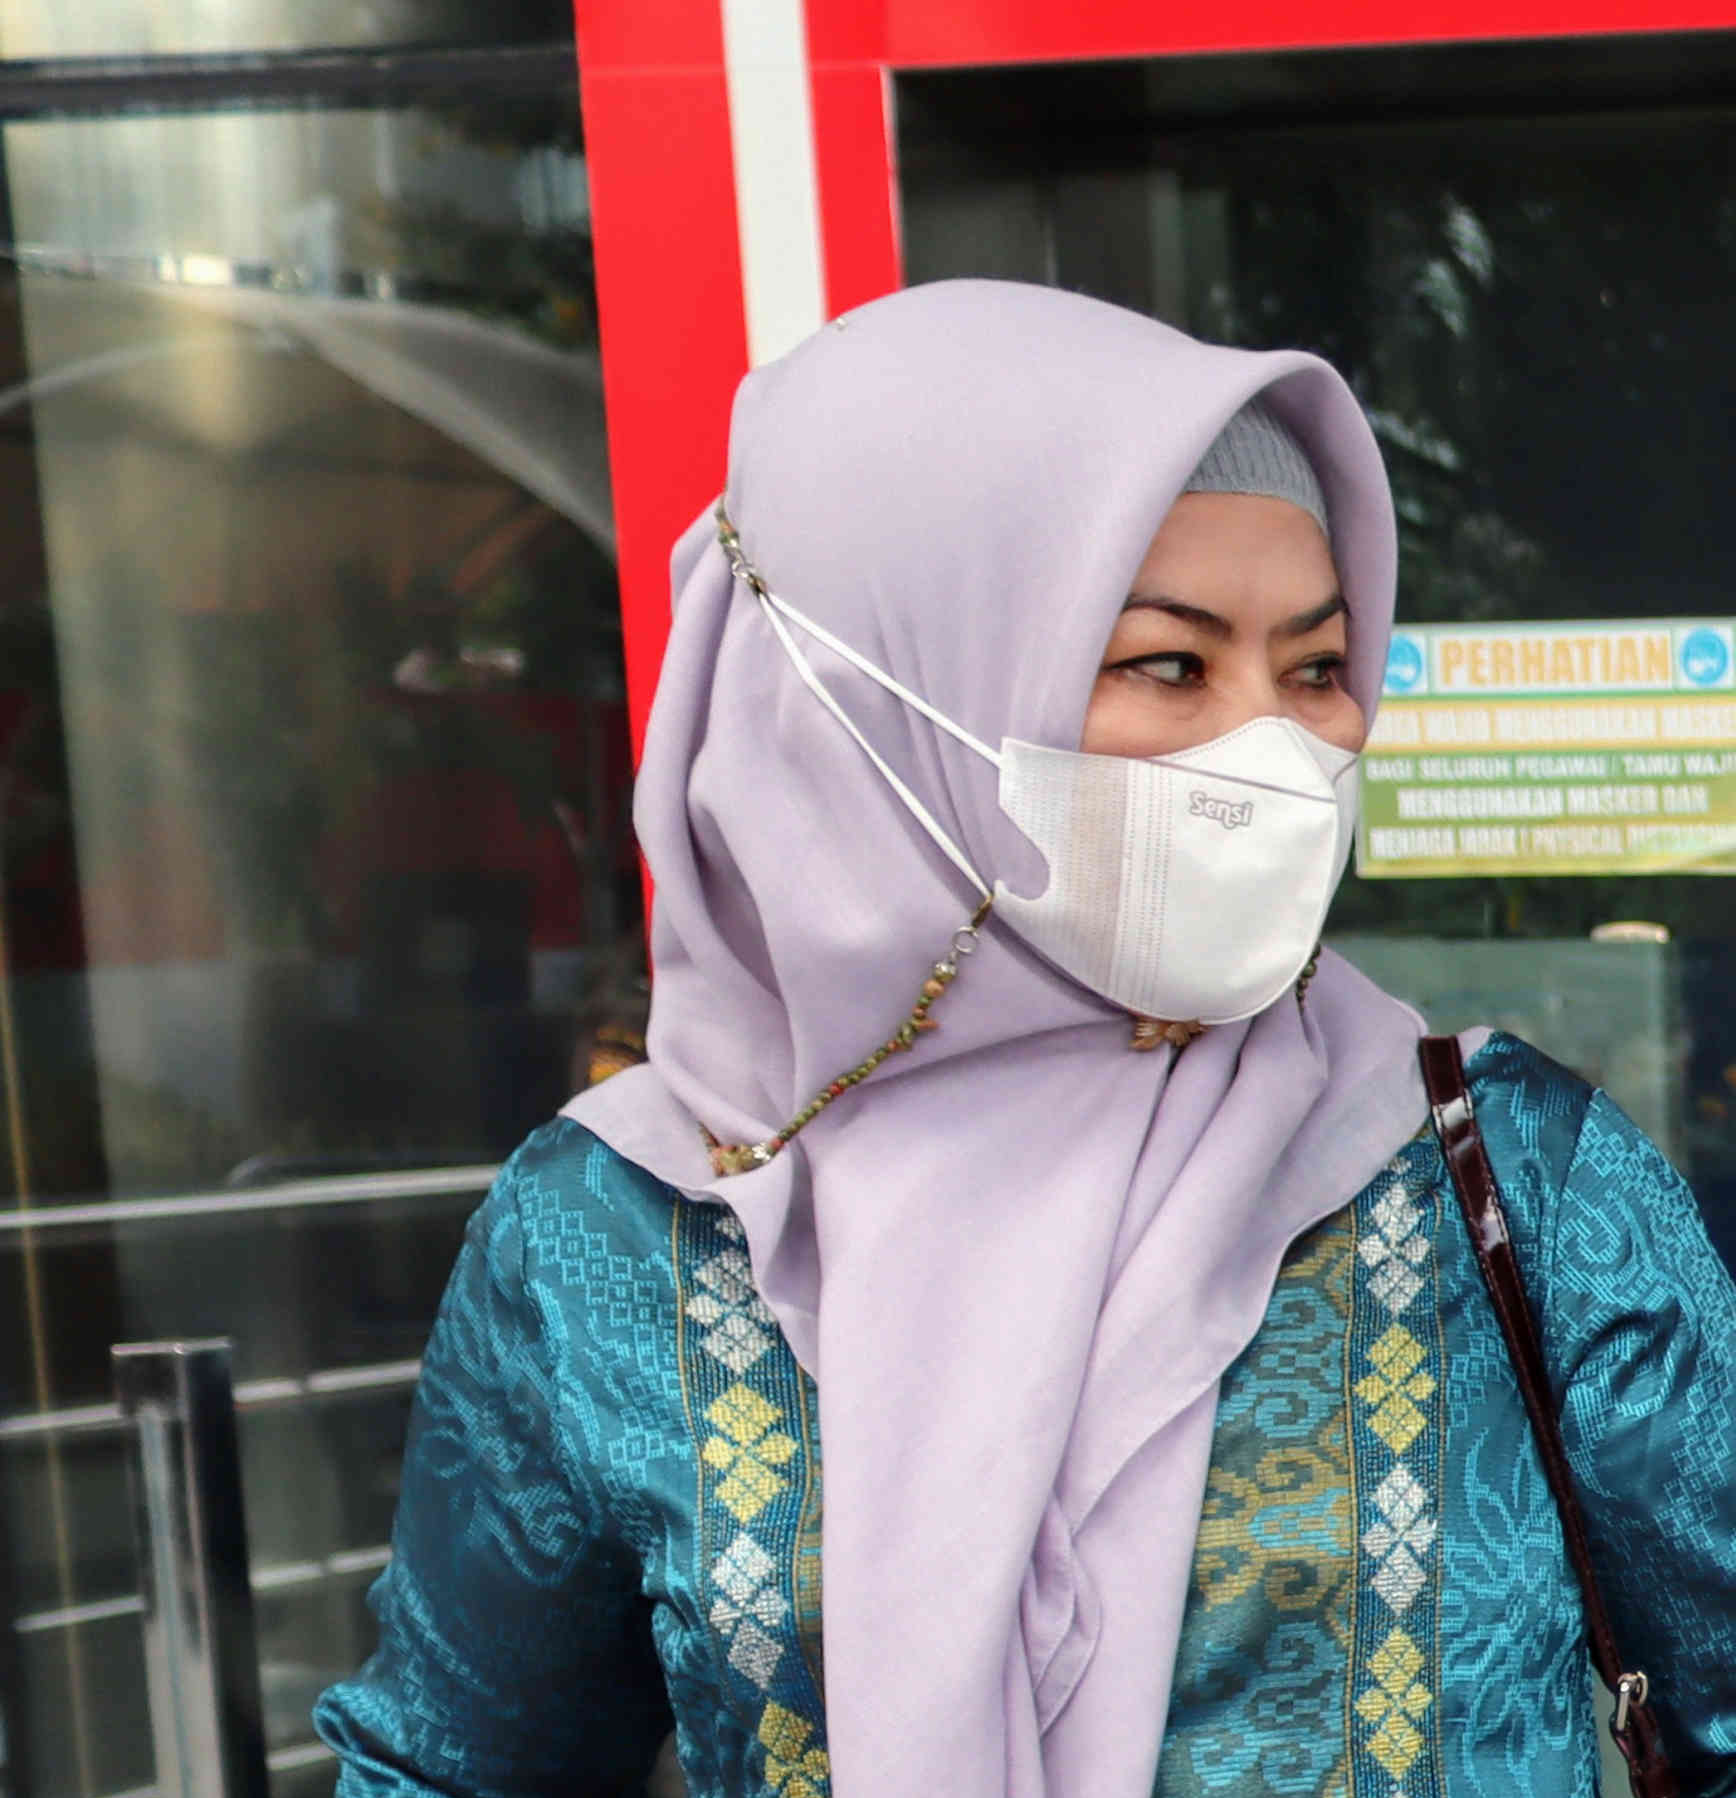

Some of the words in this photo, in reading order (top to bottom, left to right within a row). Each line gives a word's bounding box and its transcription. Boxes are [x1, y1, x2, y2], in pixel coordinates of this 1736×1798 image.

[1440, 633, 1671, 686] PERHATIAN
[1367, 757, 1414, 782] BAGI
[1420, 756, 1511, 781] SELURUH
[1515, 755, 1607, 779] PEGAWAI
[1625, 753, 1681, 777] TAMU
[1188, 790, 1254, 830] Sensi
